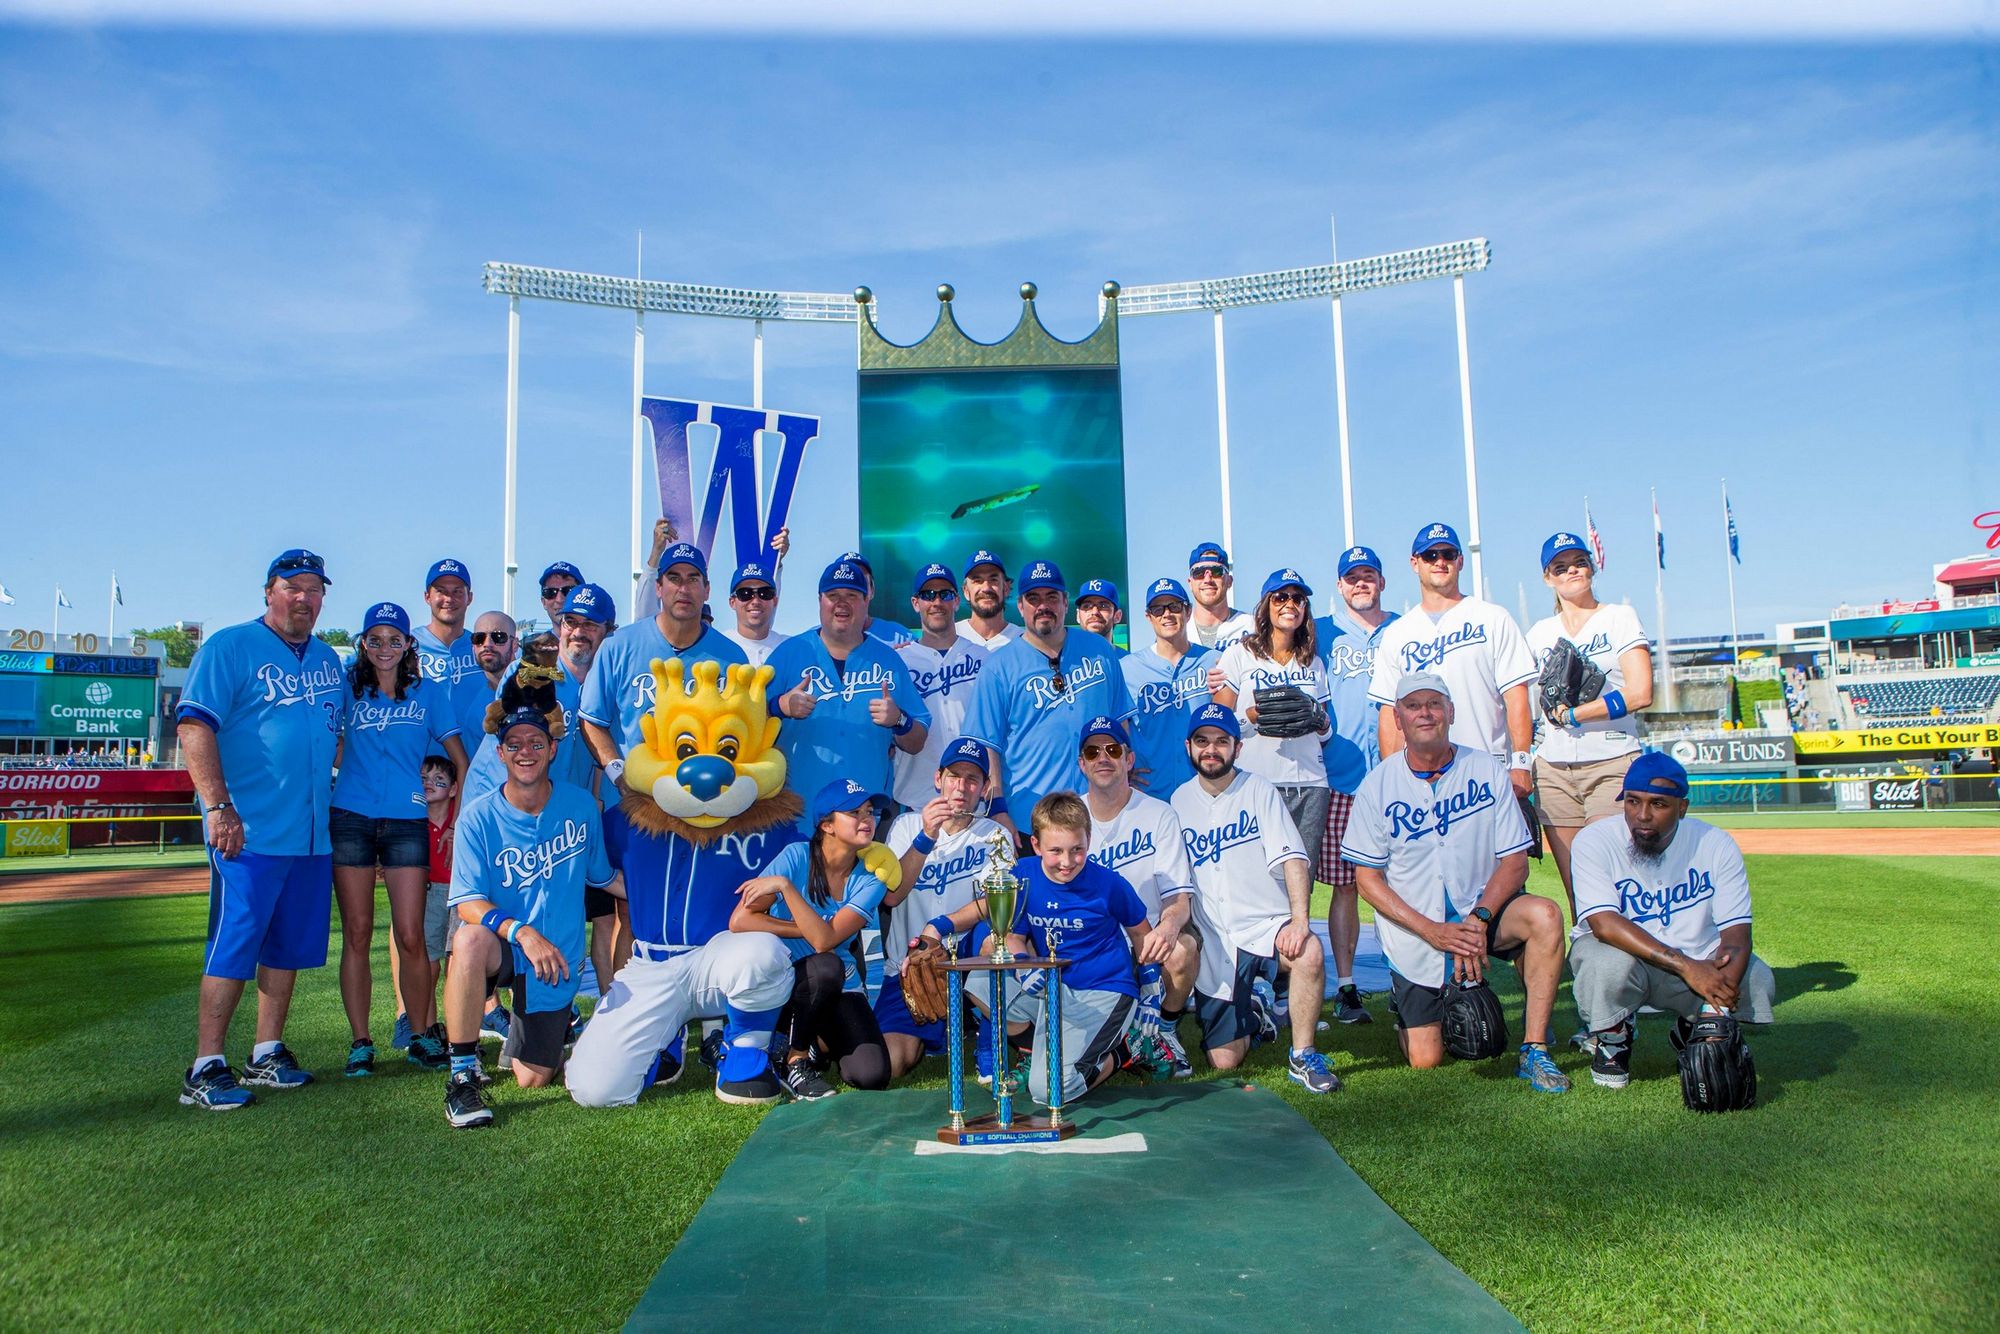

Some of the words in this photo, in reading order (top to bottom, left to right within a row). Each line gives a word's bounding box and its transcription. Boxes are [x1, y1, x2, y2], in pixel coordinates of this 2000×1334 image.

[641, 395, 820, 578] W
[1428, 530, 1449, 539] Slick
[1554, 538, 1576, 547] Slick
[672, 550, 695, 559] Slick
[974, 554, 993, 562] Slick
[1349, 552, 1368, 561] Slick
[439, 564, 459, 573] Slick
[742, 568, 762, 577] Slick
[833, 570, 854, 580] Slick
[926, 567, 946, 576] Slick
[1031, 569, 1052, 580] Slick
[1089, 579, 1102, 591] KC
[1282, 572, 1300, 582] Slick
[1154, 583, 1173, 592] Slick
[572, 594, 595, 606] Slick
[376, 610, 397, 619] Slick
[9, 628, 45, 651] 20
[70, 632, 98, 653] 10
[131, 636, 148, 656] 5
[1401, 622, 1487, 672] Royals
[0, 653, 34, 670] Slick
[419, 653, 481, 685] Royal
[257, 661, 342, 706] Royals
[908, 654, 982, 699] Royals
[1026, 656, 1106, 709] Royals
[1250, 667, 1316, 690] Royals
[1138, 668, 1210, 715] Royal
[51, 704, 143, 719] Commerce
[350, 700, 426, 732] Royals
[1201, 710, 1224, 720] Slick
[75, 720, 120, 733] Bank
[1090, 722, 1111, 731] Slick
[1799, 738, 1829, 750] Sprint
[1858, 733, 1893, 747] The
[1898, 732, 1931, 745] Cut
[1935, 731, 1980, 744] Your
[958, 746, 980, 758] Slick
[1841, 782, 1865, 801] BIG
[1873, 777, 1921, 801] Slick
[1385, 778, 1496, 843] Royals
[12, 827, 62, 847] Slick
[1182, 810, 1261, 868] Royals
[495, 819, 588, 890] Royals
[716, 831, 766, 870] KC
[1088, 828, 1156, 871] oyals
[914, 845, 986, 895] oyals
[1615, 868, 1716, 927] Royals
[1028, 912, 1084, 929] ROYALS
[987, 1133, 1017, 1141] SOFTBALL
[1018, 1131, 1053, 1139] CHAMPIONS
